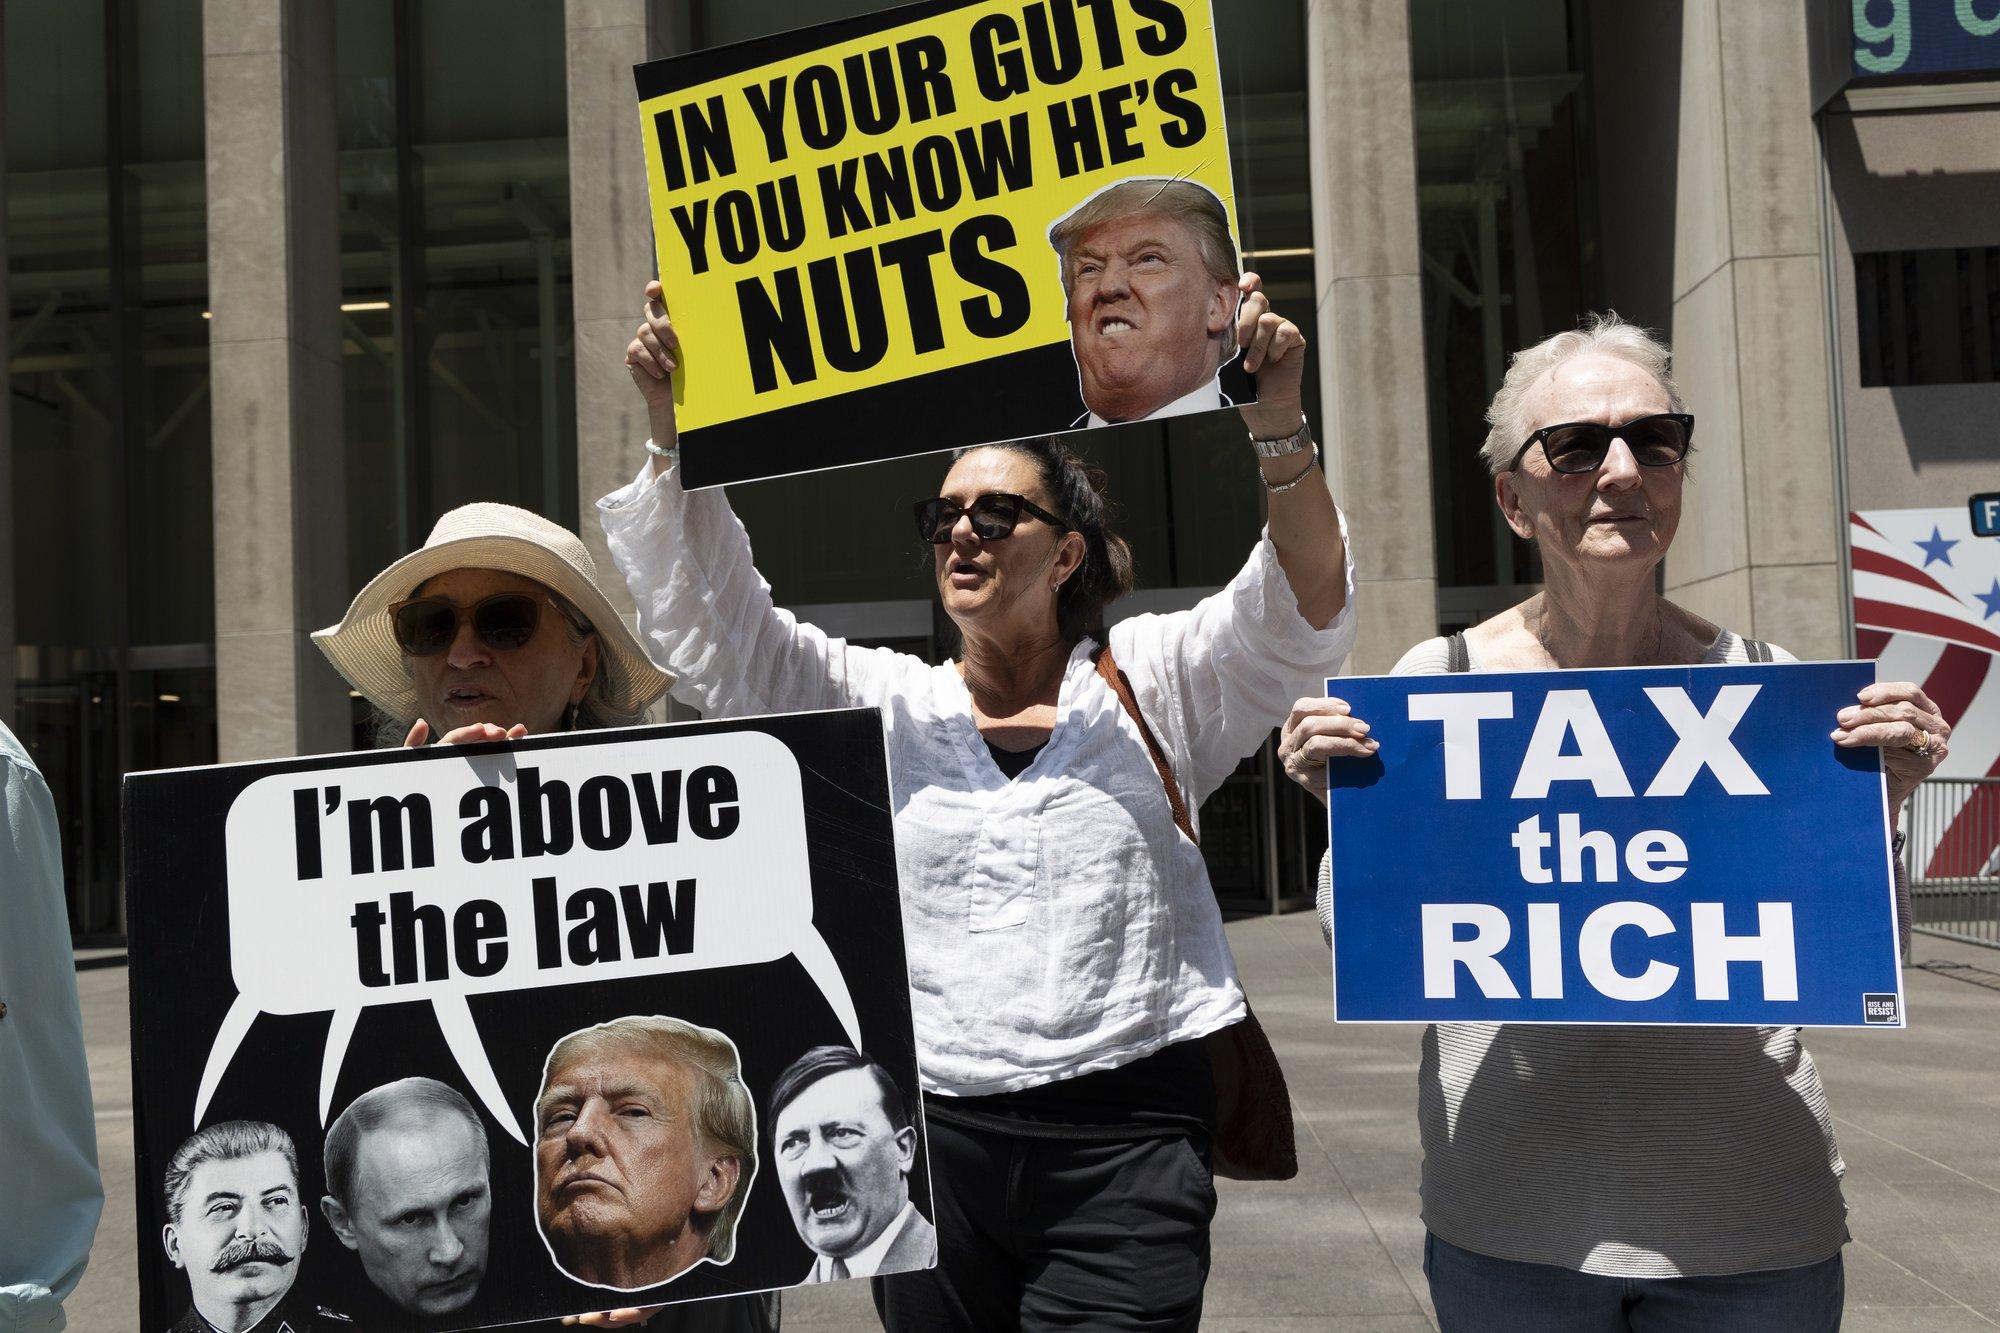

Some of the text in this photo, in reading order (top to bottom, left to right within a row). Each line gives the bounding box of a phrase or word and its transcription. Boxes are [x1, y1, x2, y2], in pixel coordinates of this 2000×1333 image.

[653, 0, 1187, 192] IN YOUR GUTS
[670, 69, 1207, 275] YOU KNOW HE'S
[735, 215, 1031, 395] NUTS
[1407, 684, 1771, 799] TAX
[293, 765, 740, 881] I'm above
[1511, 813, 1689, 884] the
[350, 877, 697, 988] the law
[1421, 900, 1799, 1002] RICH
[1868, 1008, 1895, 1016] RESIST
